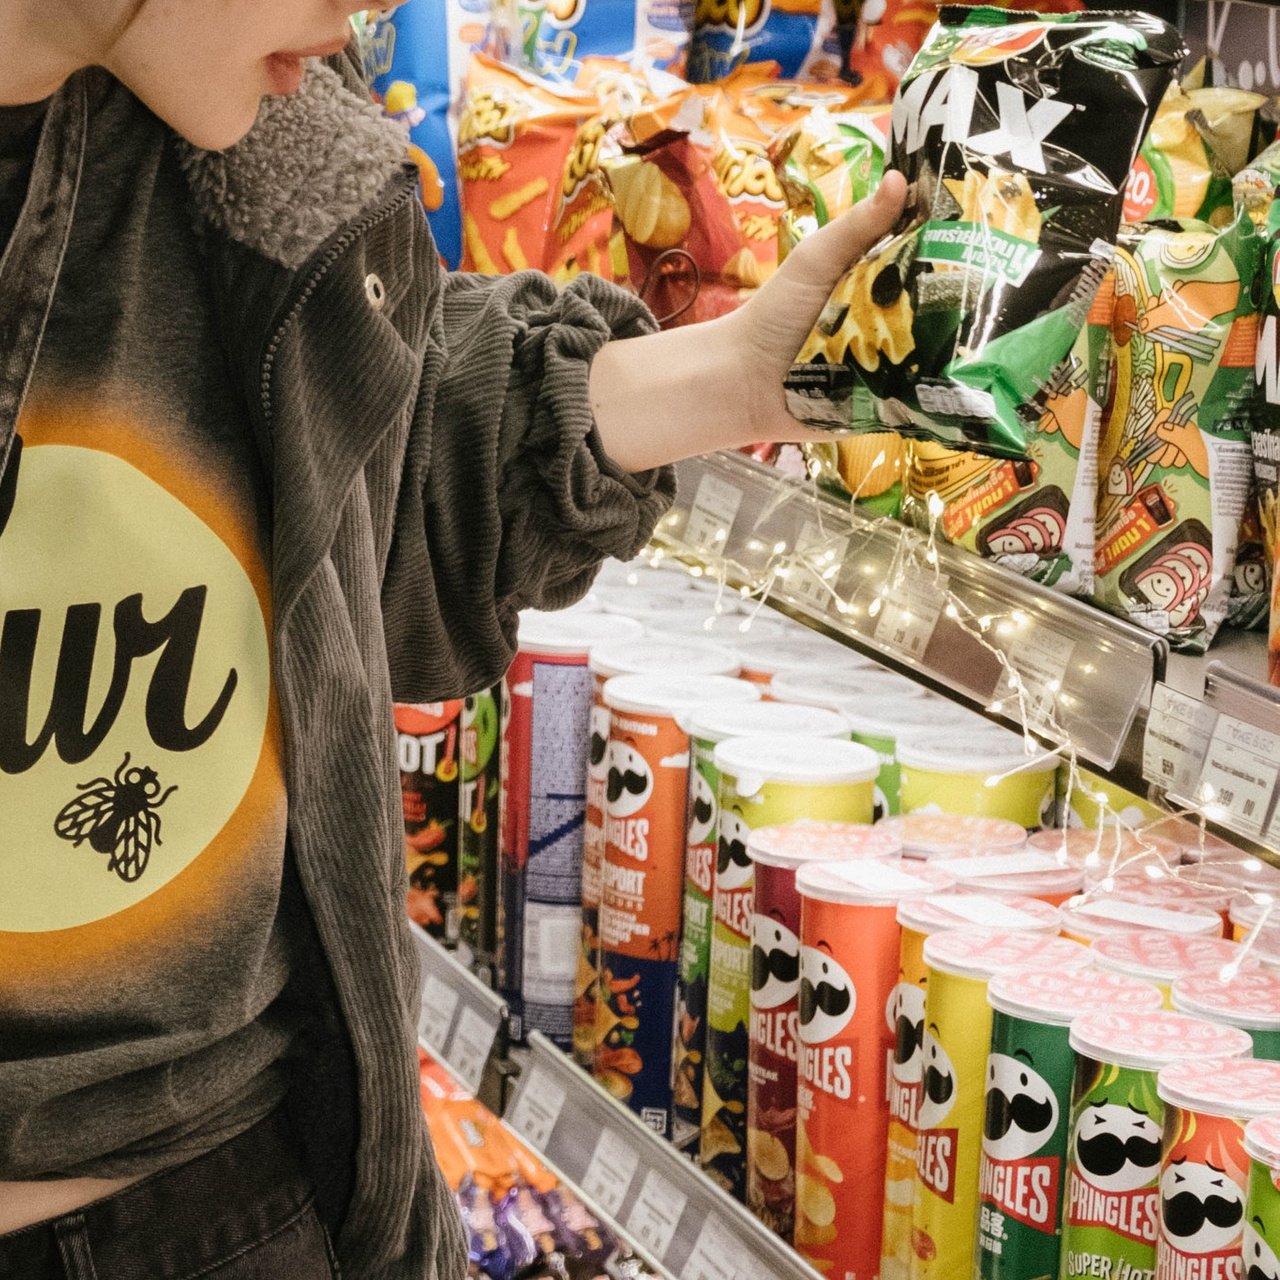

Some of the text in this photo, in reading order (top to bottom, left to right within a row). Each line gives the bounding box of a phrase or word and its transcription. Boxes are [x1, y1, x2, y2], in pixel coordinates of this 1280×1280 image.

[890, 64, 1074, 175] MAX
[399, 732, 446, 775] OT
[1070, 1177, 1158, 1241] PRINGLES
